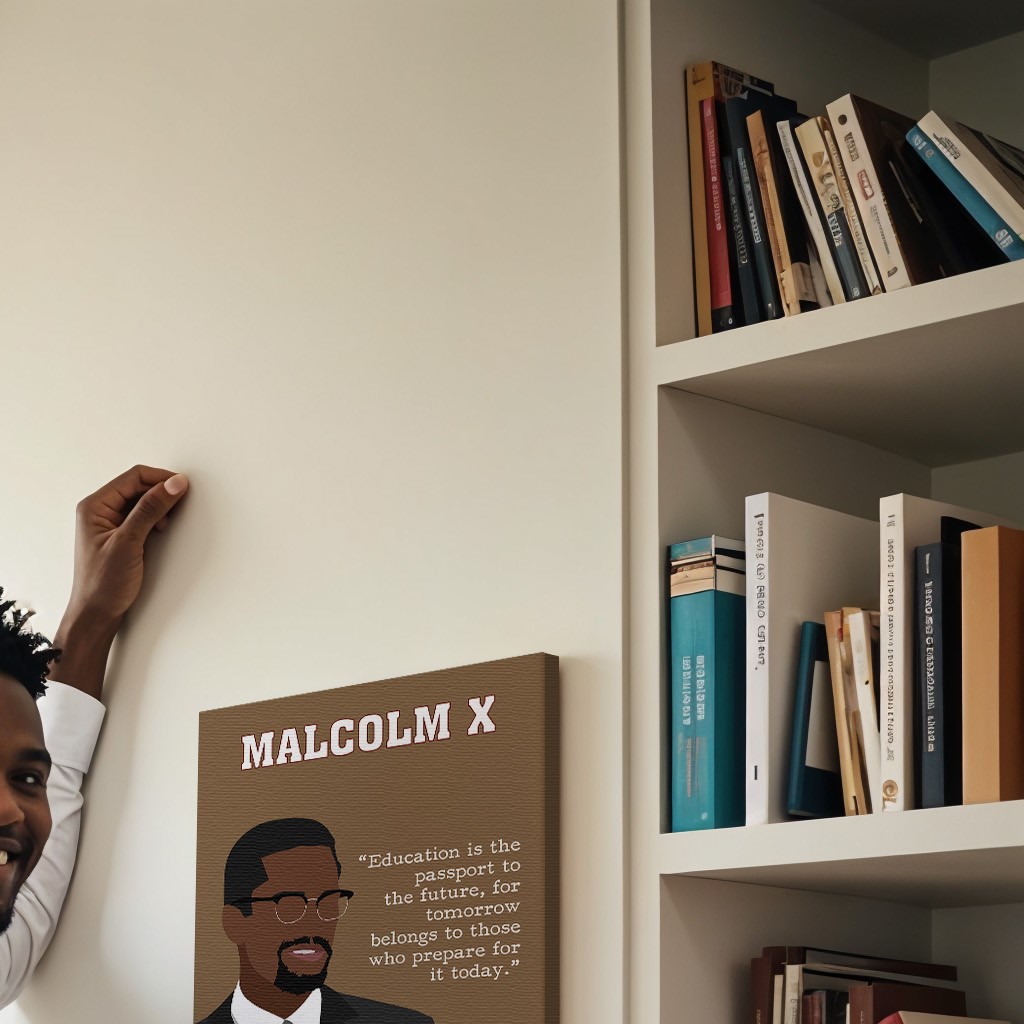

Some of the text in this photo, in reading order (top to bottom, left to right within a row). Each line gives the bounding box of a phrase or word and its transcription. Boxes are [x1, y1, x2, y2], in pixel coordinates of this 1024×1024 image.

[241, 694, 496, 771] MALCOLM X
[467, 842, 483, 857] is
[489, 838, 521, 854] the
[414, 859, 521, 888] passport to
[384, 878, 521, 906] the future, for
[425, 901, 521, 922] tomorrow
[370, 922, 521, 948] belongs to those
[368, 940, 521, 968] who prepare for
[430, 967, 445, 982] it
